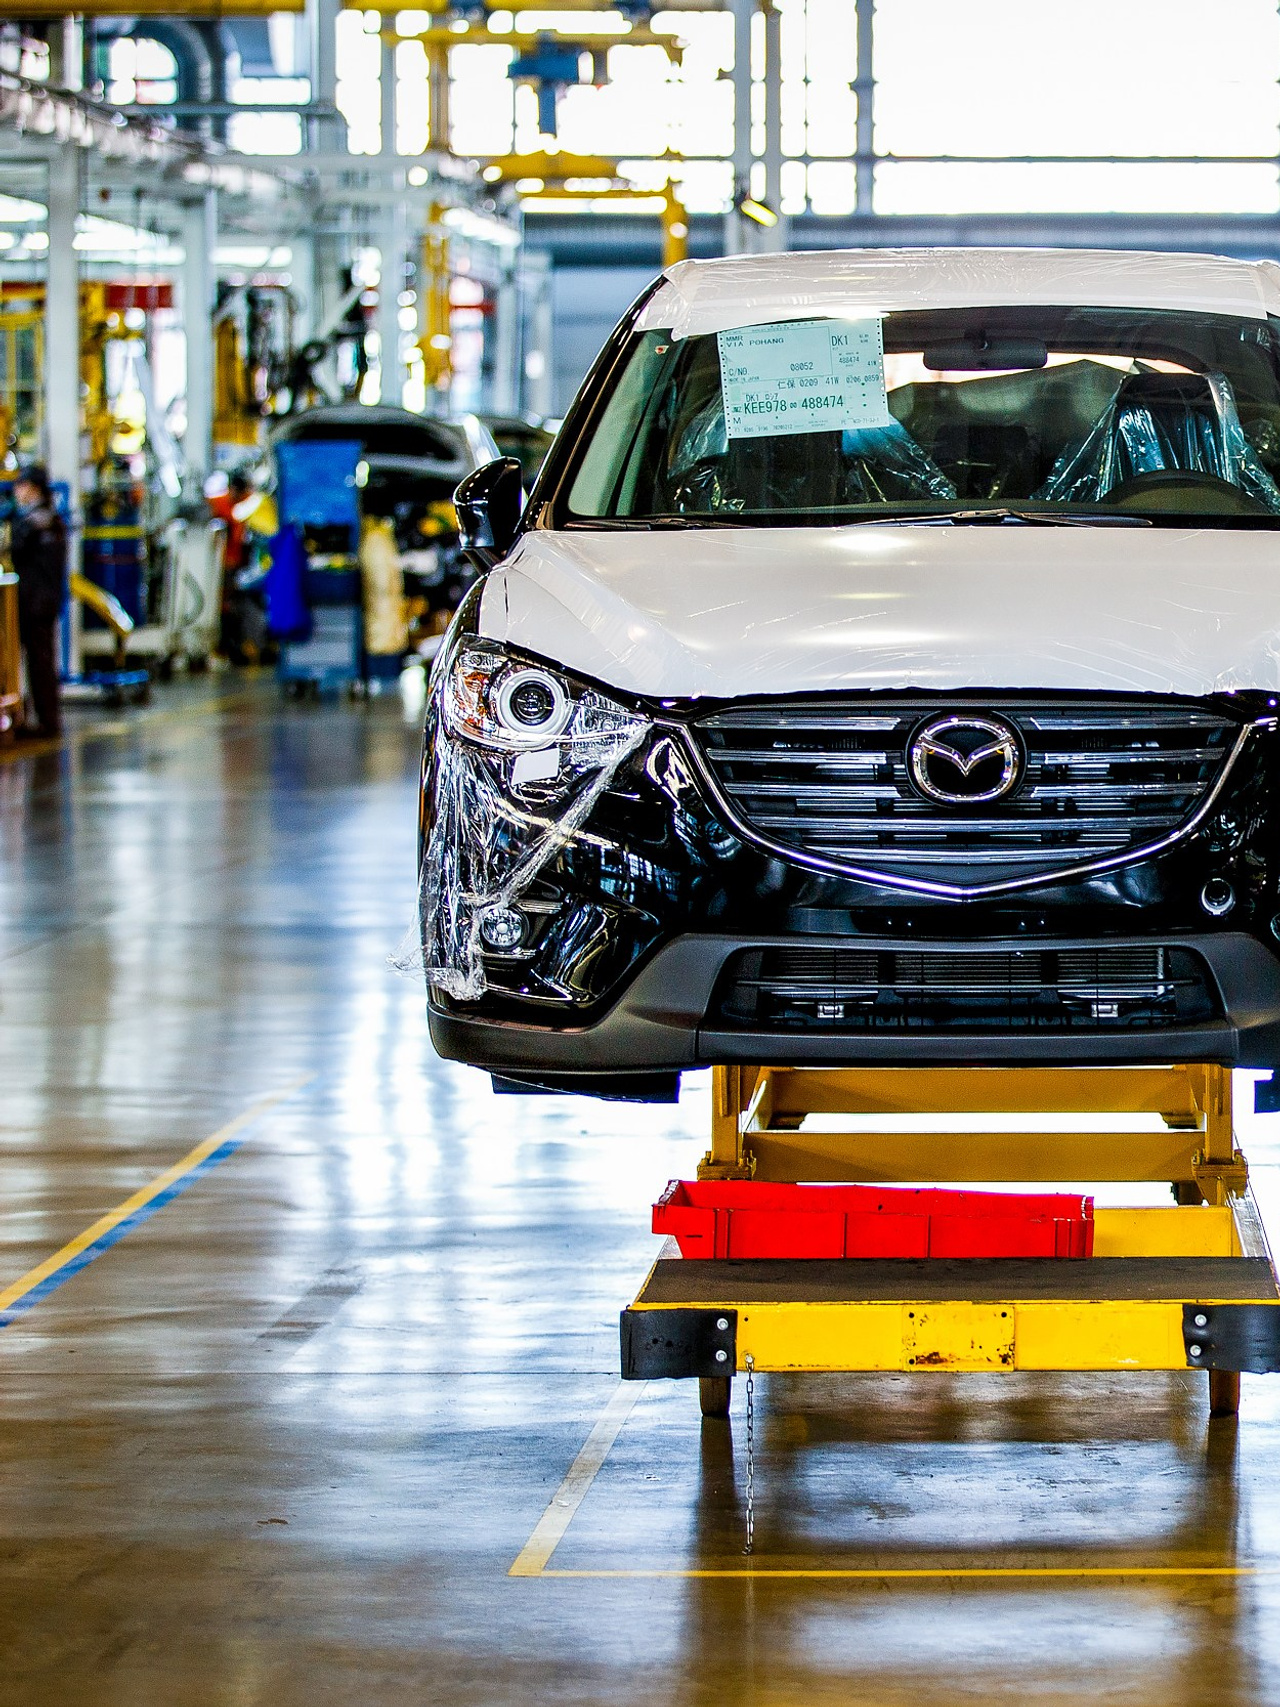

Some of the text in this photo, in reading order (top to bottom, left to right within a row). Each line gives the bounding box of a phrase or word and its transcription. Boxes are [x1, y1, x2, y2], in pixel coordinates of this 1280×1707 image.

[749, 337, 784, 346] POHANG
[831, 335, 848, 346] DK1
[743, 399, 787, 415] KEE978
[801, 394, 844, 410] 488474
[733, 416, 742, 425] M
